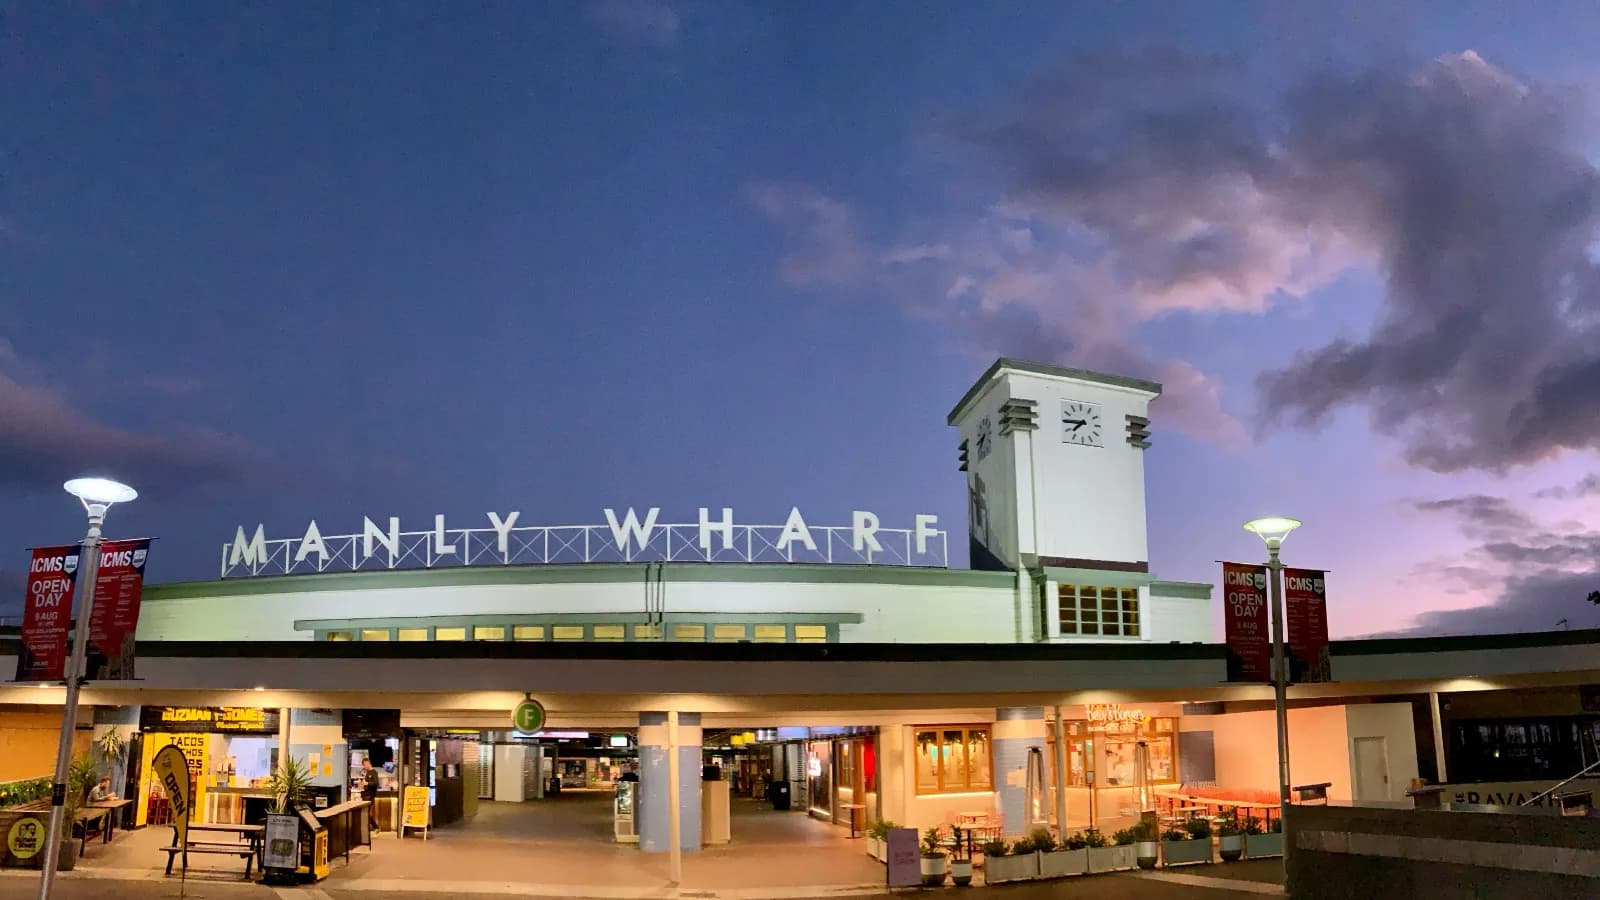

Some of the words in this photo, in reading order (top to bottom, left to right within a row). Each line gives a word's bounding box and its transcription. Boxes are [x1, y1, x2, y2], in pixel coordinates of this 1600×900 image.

[229, 511, 520, 566] MANLY
[603, 506, 938, 553] WHARF
[31, 556, 63, 573] ICMS
[100, 550, 132, 568] ICMS
[32, 578, 71, 594] OPEN
[1225, 571, 1253, 586] ICMS
[1286, 577, 1312, 591] ICMS
[35, 593, 63, 607] DAY
[1229, 592, 1263, 606] OPEN
[1235, 605, 1258, 617] DAY
[162, 708, 211, 721] GUZMAN
[524, 709, 534, 726] F
[170, 736, 204, 747] TACOS
[164, 772, 186, 816] OPEN
